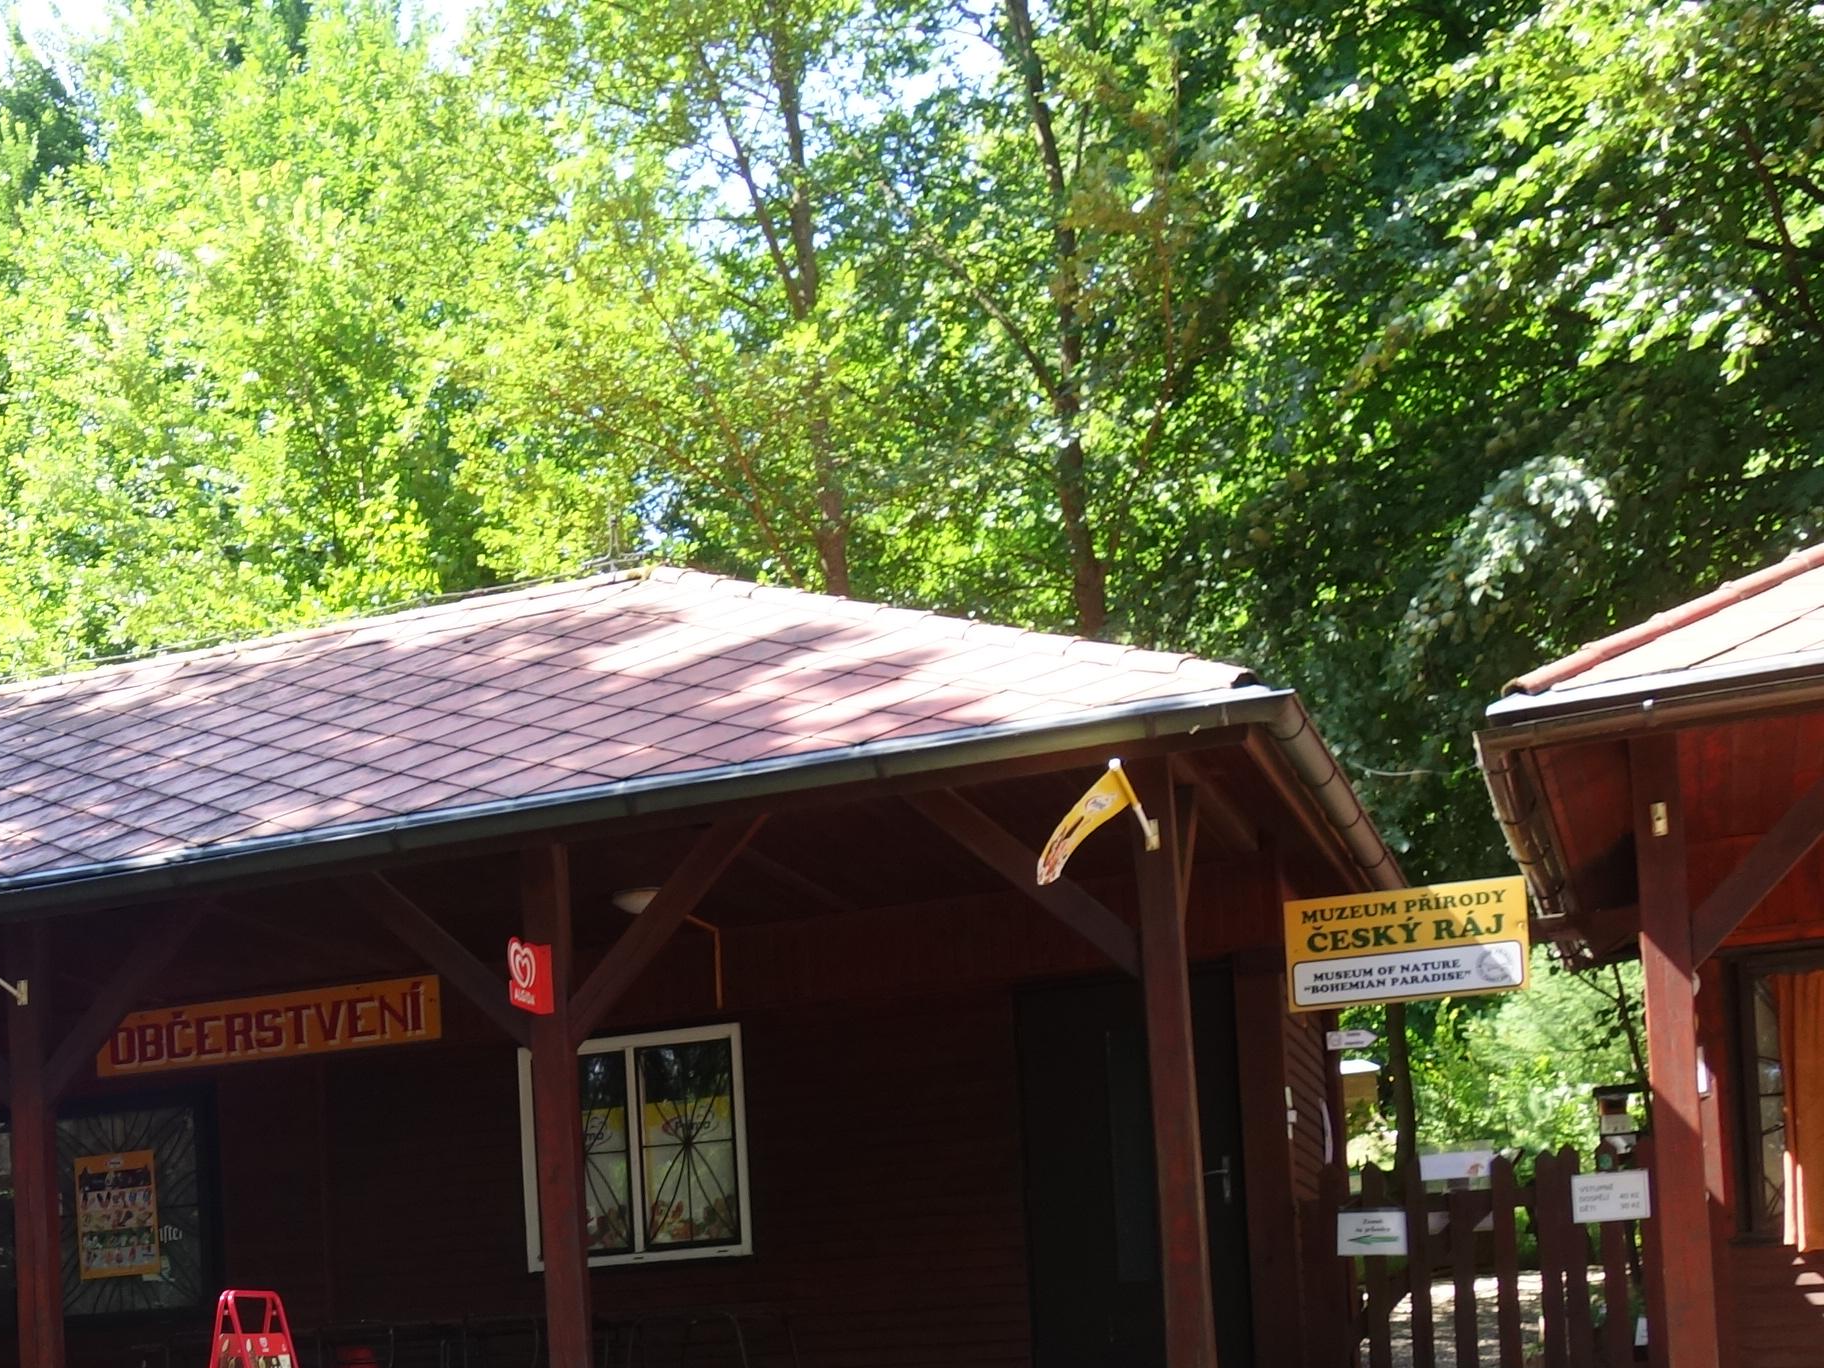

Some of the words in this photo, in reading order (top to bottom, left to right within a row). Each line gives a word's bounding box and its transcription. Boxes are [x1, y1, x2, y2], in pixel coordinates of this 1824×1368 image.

[1302, 901, 1397, 925] MUZEUM
[1404, 889, 1506, 914] PŘÍRODY
[1307, 916, 1422, 953] ČESKÝ
[1433, 911, 1505, 941] RÁJ
[1313, 966, 1373, 982] MUSEUM
[1377, 964, 1395, 976] OF
[1400, 958, 1461, 973] NATURE
[110, 981, 425, 1067] OBČERSTVENÍ
